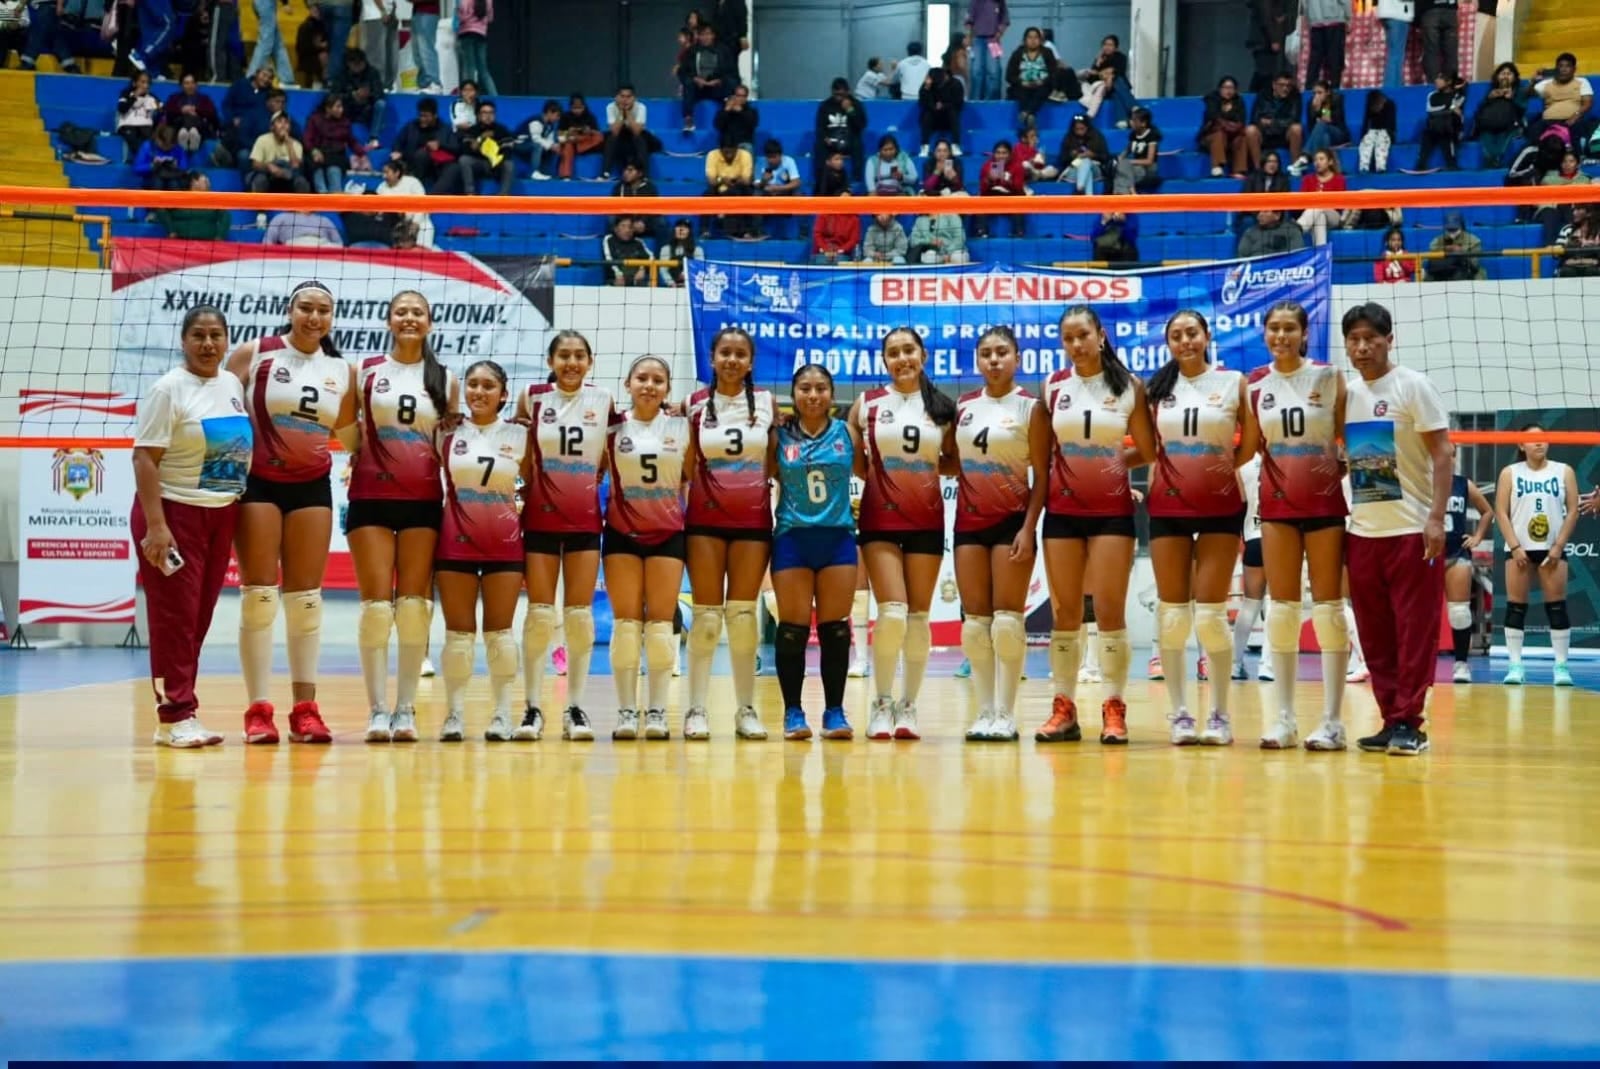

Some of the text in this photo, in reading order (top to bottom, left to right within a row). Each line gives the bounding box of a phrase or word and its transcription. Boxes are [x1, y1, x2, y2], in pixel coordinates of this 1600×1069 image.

[880, 276, 1130, 302] BIENVENIDOS
[239, 293, 392, 320] CAMNATO
[431, 302, 508, 325] CIONAL
[1115, 321, 1149, 337] DE
[934, 348, 962, 375] EL
[299, 386, 319, 414] 2
[397, 394, 417, 424] 8
[1083, 410, 1092, 439] 1
[1183, 407, 1199, 436] 11
[1280, 407, 1305, 438] 10
[558, 426, 583, 456] 12
[724, 428, 743, 455] 3
[902, 425, 921, 453] 9
[972, 427, 990, 455] 4
[477, 456, 495, 486] 7
[639, 454, 658, 483] 5
[807, 470, 827, 504] 6
[1516, 476, 1560, 498] SURCO
[1535, 498, 1543, 511] 6
[28, 515, 128, 527] MIRAFLORES
